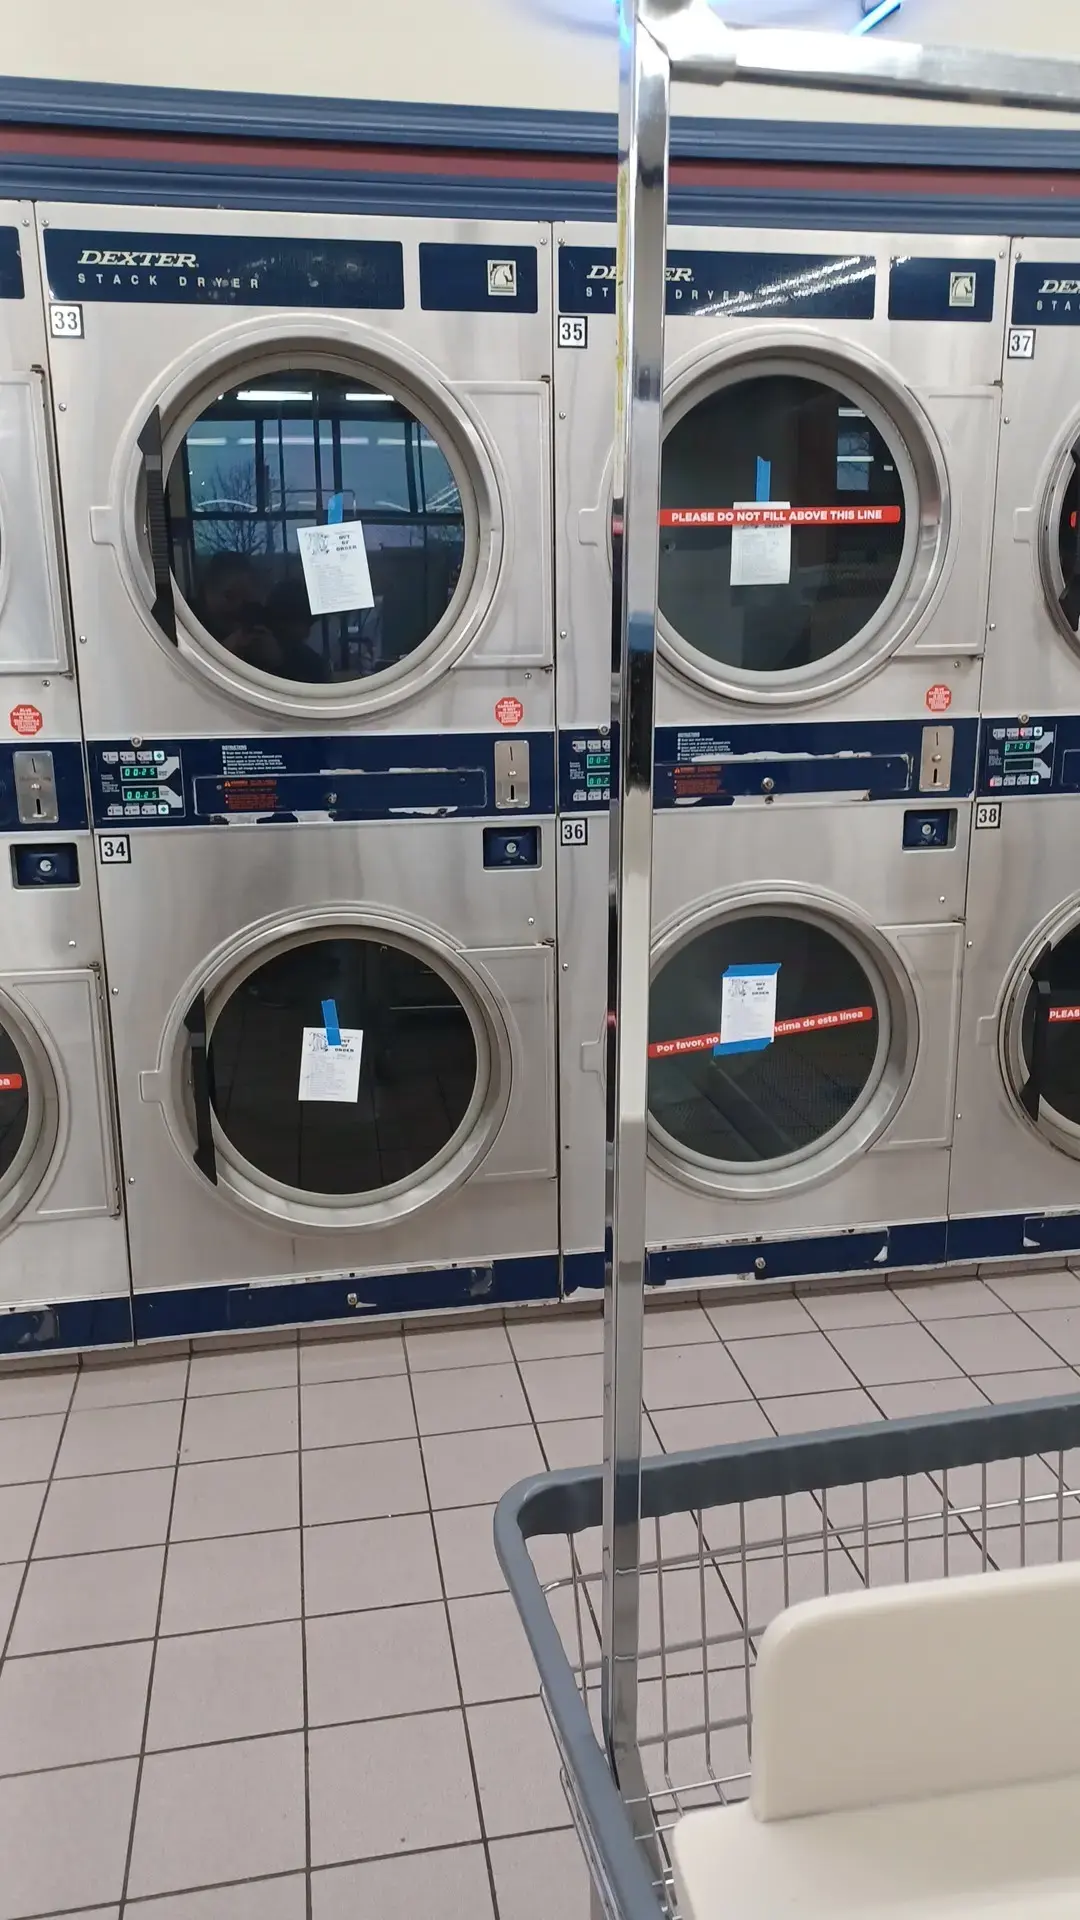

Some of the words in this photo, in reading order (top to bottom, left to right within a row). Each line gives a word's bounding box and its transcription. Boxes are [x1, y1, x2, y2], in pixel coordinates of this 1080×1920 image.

[77, 249, 198, 268] DEXTER
[77, 274, 158, 286] STACK
[179, 276, 259, 289] DRYER
[54, 311, 78, 330] 33
[561, 323, 583, 341] 35
[1011, 334, 1031, 352] 37
[671, 512, 715, 522] PLEASE
[717, 511, 734, 522] DO
[737, 511, 760, 521] NOT
[763, 511, 786, 521] FILL
[789, 510, 828, 521] ABOVE
[830, 510, 855, 520] THIS
[857, 509, 882, 520] LINE
[978, 808, 997, 823] 38
[564, 823, 583, 840] 36
[103, 841, 126, 857] 34
[1049, 1008, 1080, 1019] PLEAS
[656, 1044, 675, 1053] Por
[676, 1039, 705, 1050] favor,
[706, 1036, 719, 1045] no
[803, 1018, 816, 1028] de
[817, 1015, 838, 1025] esta
[839, 1010, 864, 1021] línea
